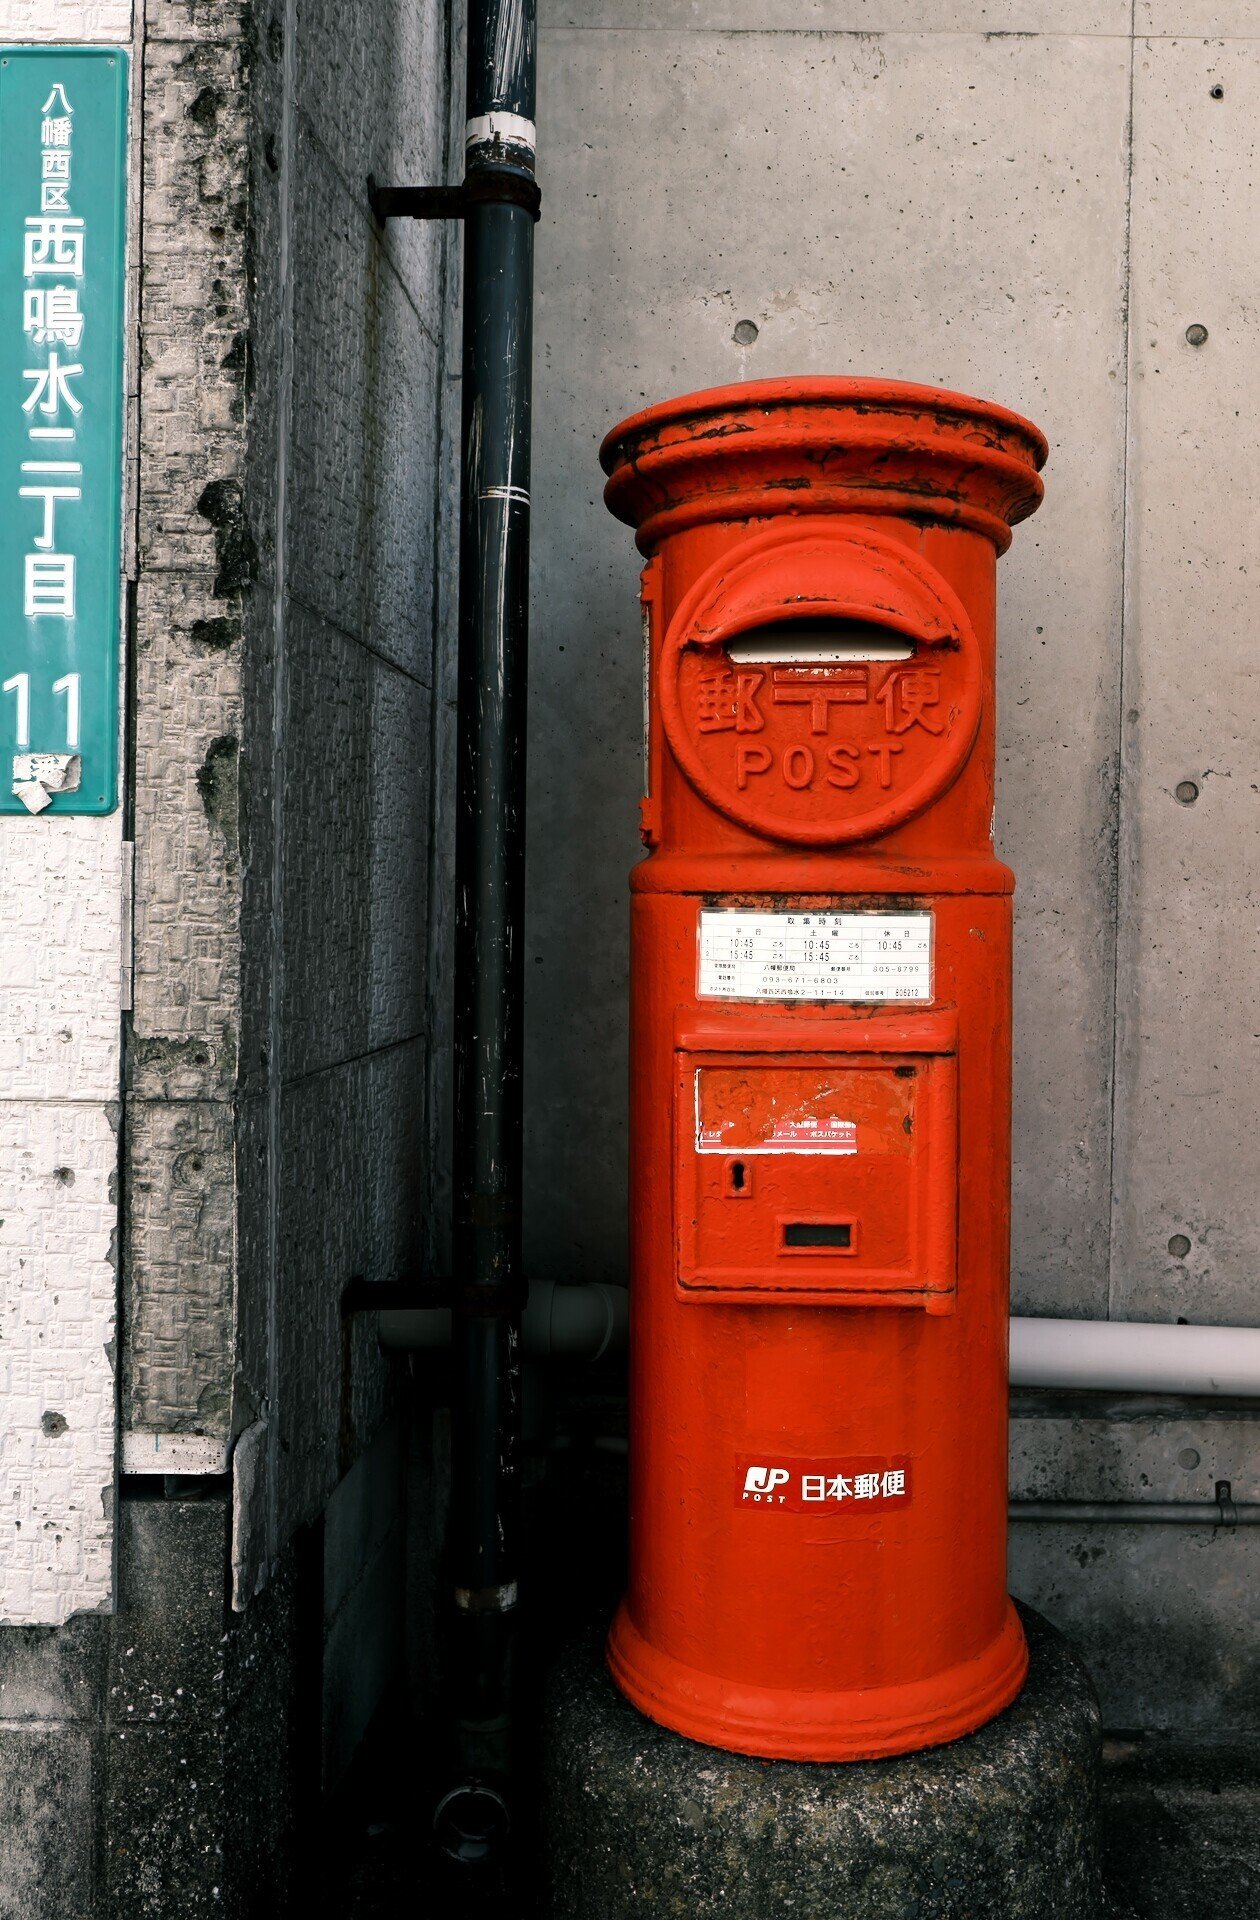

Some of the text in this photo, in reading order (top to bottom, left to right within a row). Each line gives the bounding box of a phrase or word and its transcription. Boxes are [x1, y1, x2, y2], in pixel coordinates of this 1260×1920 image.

[41, 83, 74, 212] 八幡西区
[19, 216, 84, 617] 西鳴水二丁目
[2, 672, 81, 747] 11
[736, 742, 904, 790] POST
[730, 938, 755, 948] 10:45
[804, 940, 830, 950] 10:45
[878, 941, 902, 951] 10:45
[730, 950, 754, 960] 15:45
[803, 952, 830, 962] 15:45
[742, 1492, 786, 1503] POST
[801, 1469, 906, 1501] 日本郵便
